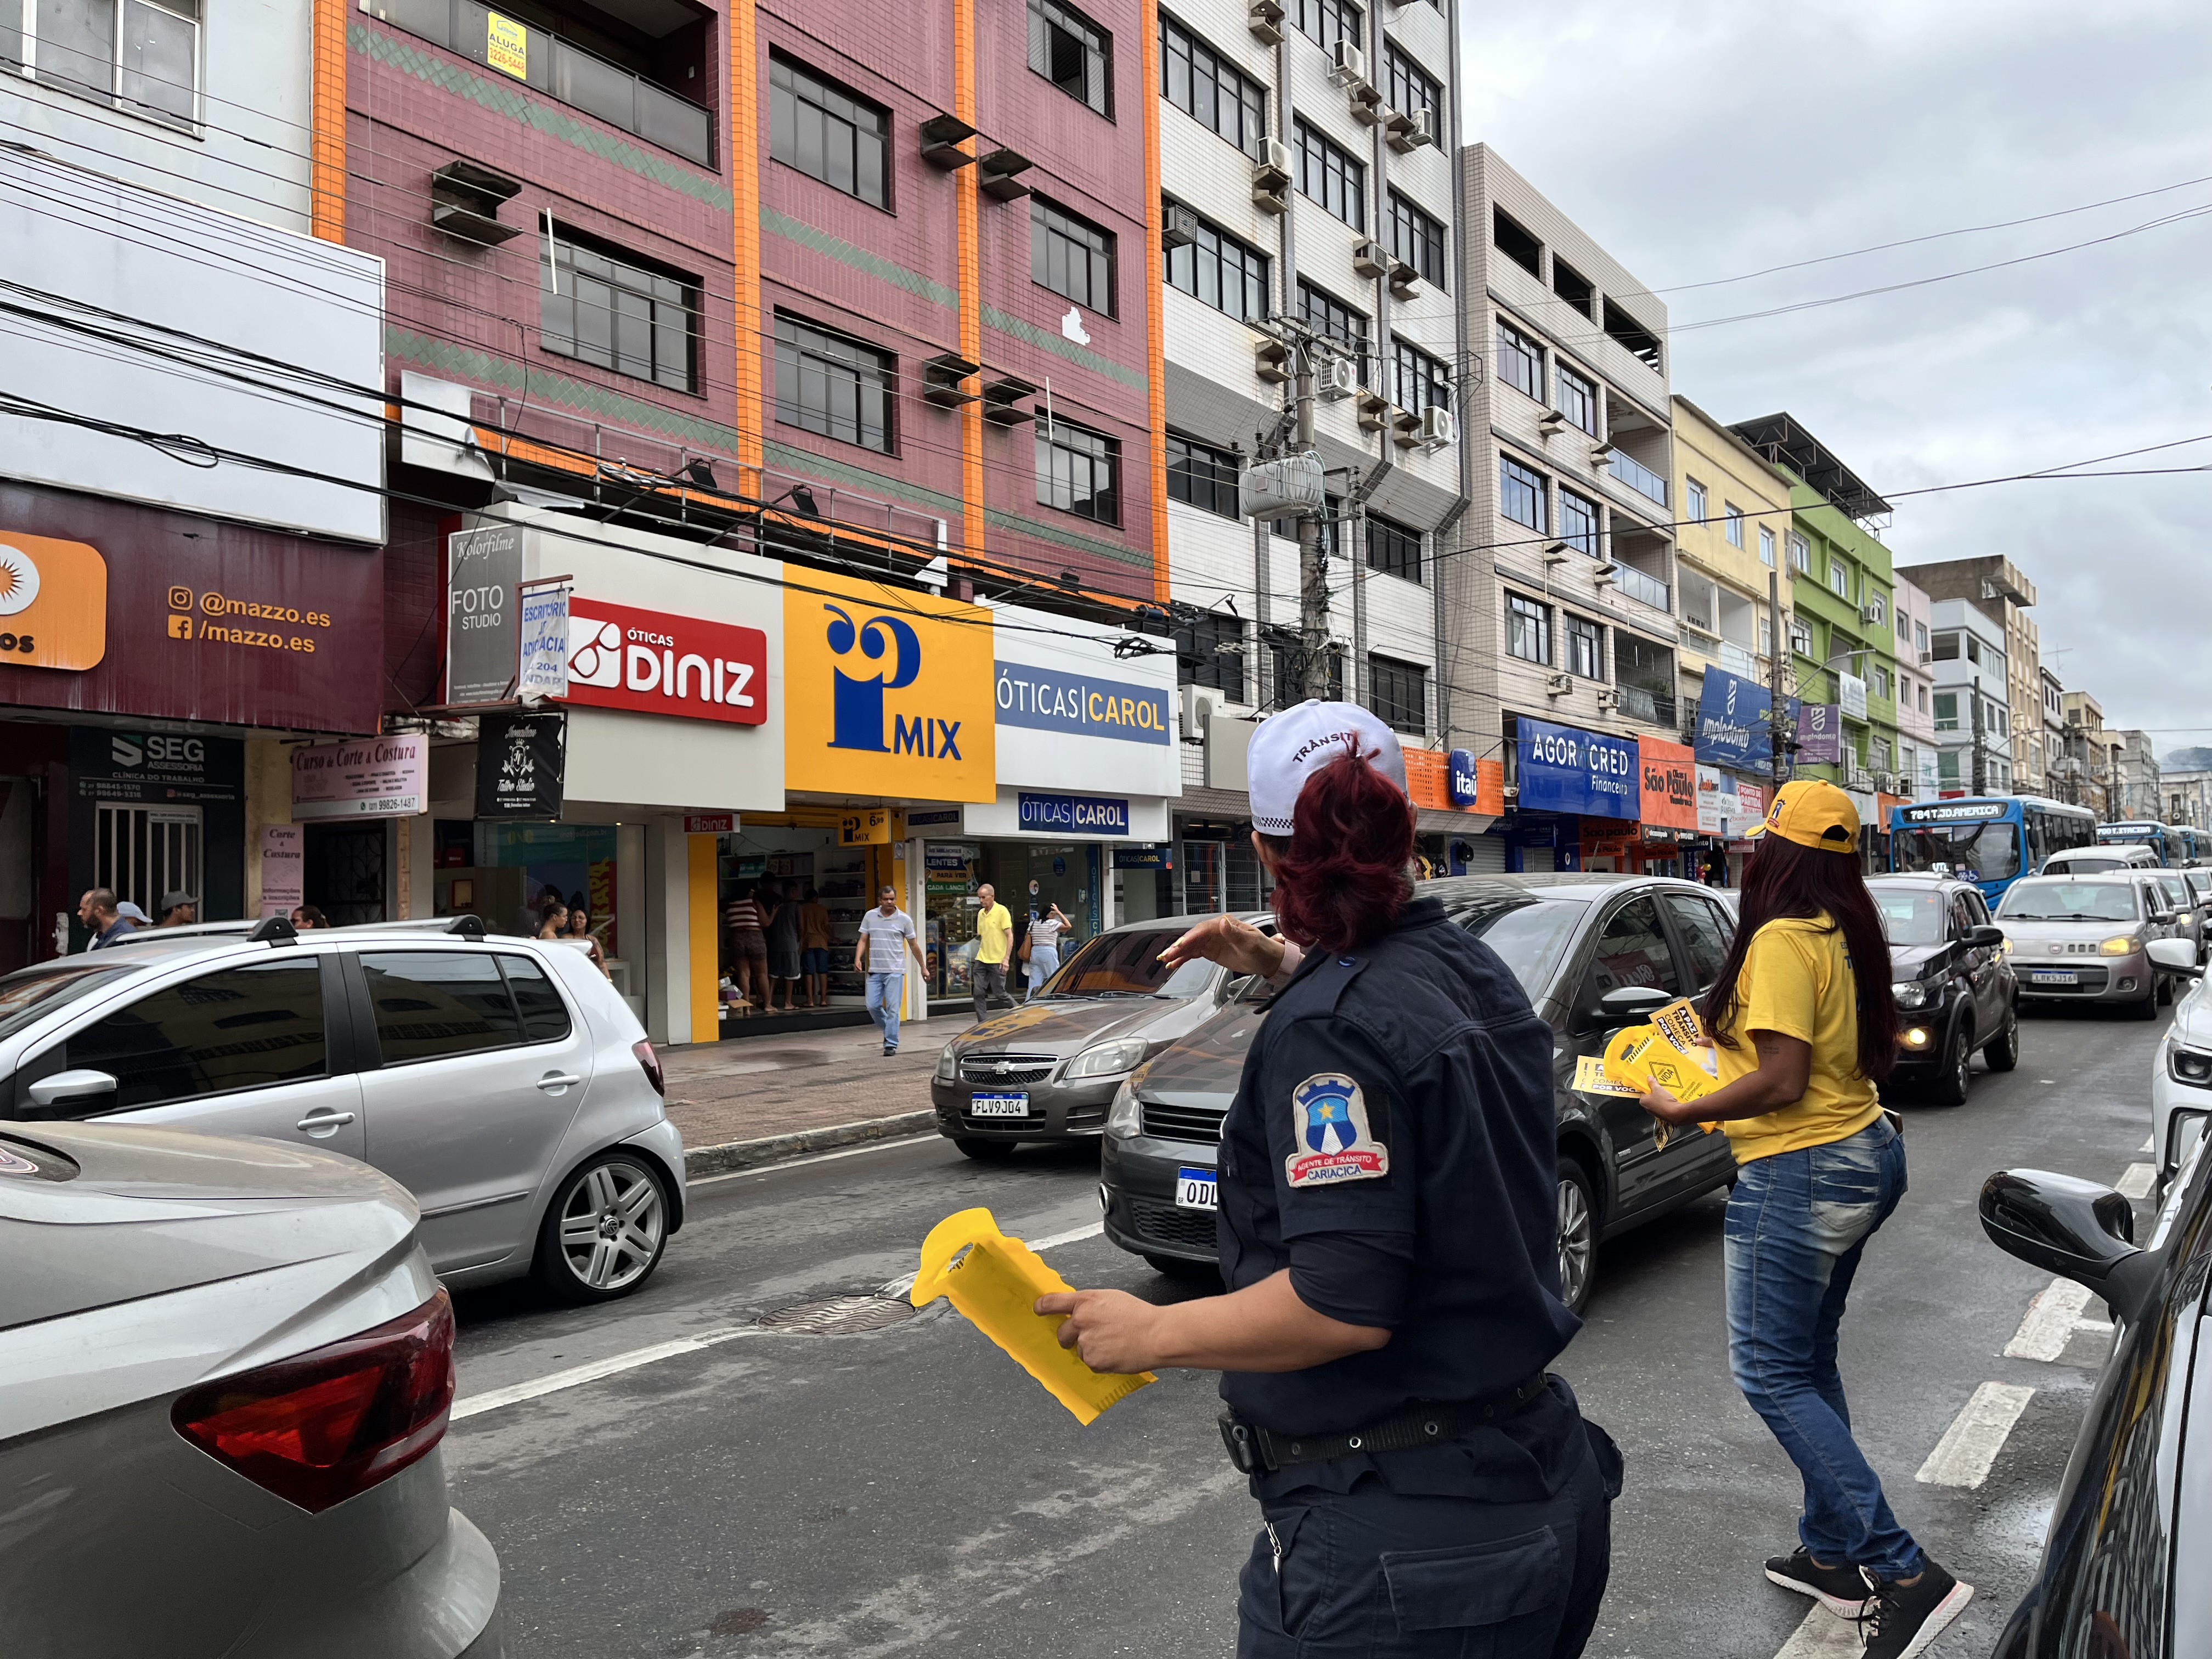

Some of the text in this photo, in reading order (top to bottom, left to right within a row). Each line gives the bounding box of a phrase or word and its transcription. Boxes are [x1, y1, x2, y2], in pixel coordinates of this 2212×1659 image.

[489, 33, 524, 55] ALUGA
[456, 534, 515, 560] Kolorfilme
[452, 585, 504, 614] FOTO
[200, 591, 330, 627] @mazzo.es
[462, 612, 501, 630] STUDIO
[199, 620, 315, 653] /mazzo.es
[627, 627, 674, 647] ÓTICAS
[537, 662, 557, 673] 204
[894, 714, 962, 760] MIX
[147, 736, 205, 763] SEG
[1293, 732, 1357, 763] TRÂNSIT
[297, 752, 325, 771] Curso
[336, 748, 363, 767] Corte
[375, 743, 416, 763] Costura
[148, 761, 204, 772] ASSESSORIA
[112, 771, 146, 780] CLÍNICA
[161, 774, 205, 783] TRABALHO
[497, 777, 535, 792] Tattoo Studio
[1456, 770, 1477, 795] itaú
[1645, 767, 1665, 792] São
[1667, 770, 1694, 798] Paulo
[1741, 787, 1755, 796] PONTO
[1741, 795, 1761, 809] PARTIDA
[933, 812, 958, 822] CAROL
[1076, 803, 1125, 826] CAROL
[1910, 810, 1930, 820] 784
[269, 828, 296, 839] Corte
[854, 833, 870, 842] MIX
[263, 849, 301, 859] Costura
[926, 858, 958, 866] LENTES
[1657, 1017, 1671, 1035] POR
[1664, 1014, 1686, 1046] COMEÇA
[1684, 1015, 1698, 1034] PAZ
[1659, 1069, 1674, 1083] VIDA
[1297, 1154, 1372, 1171] AGENTE DE TRÂNSITO
[1307, 1165, 1362, 1180] CARIACICA
